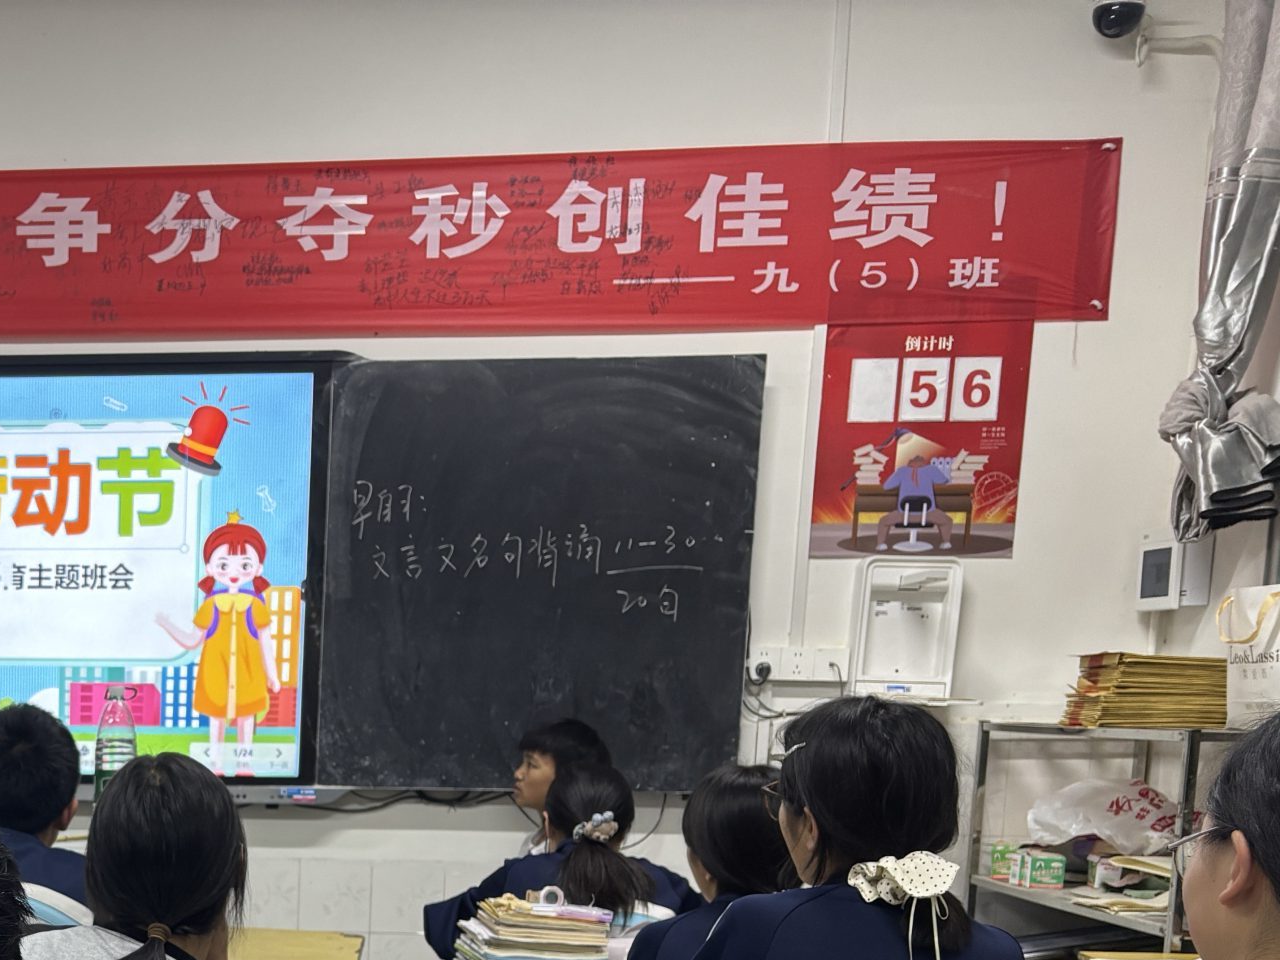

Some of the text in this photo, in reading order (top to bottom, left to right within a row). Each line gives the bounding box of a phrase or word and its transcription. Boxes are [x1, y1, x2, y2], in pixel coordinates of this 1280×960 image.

[904, 335, 955, 352] 倒计时
[233, 748, 254, 758] 1/24
